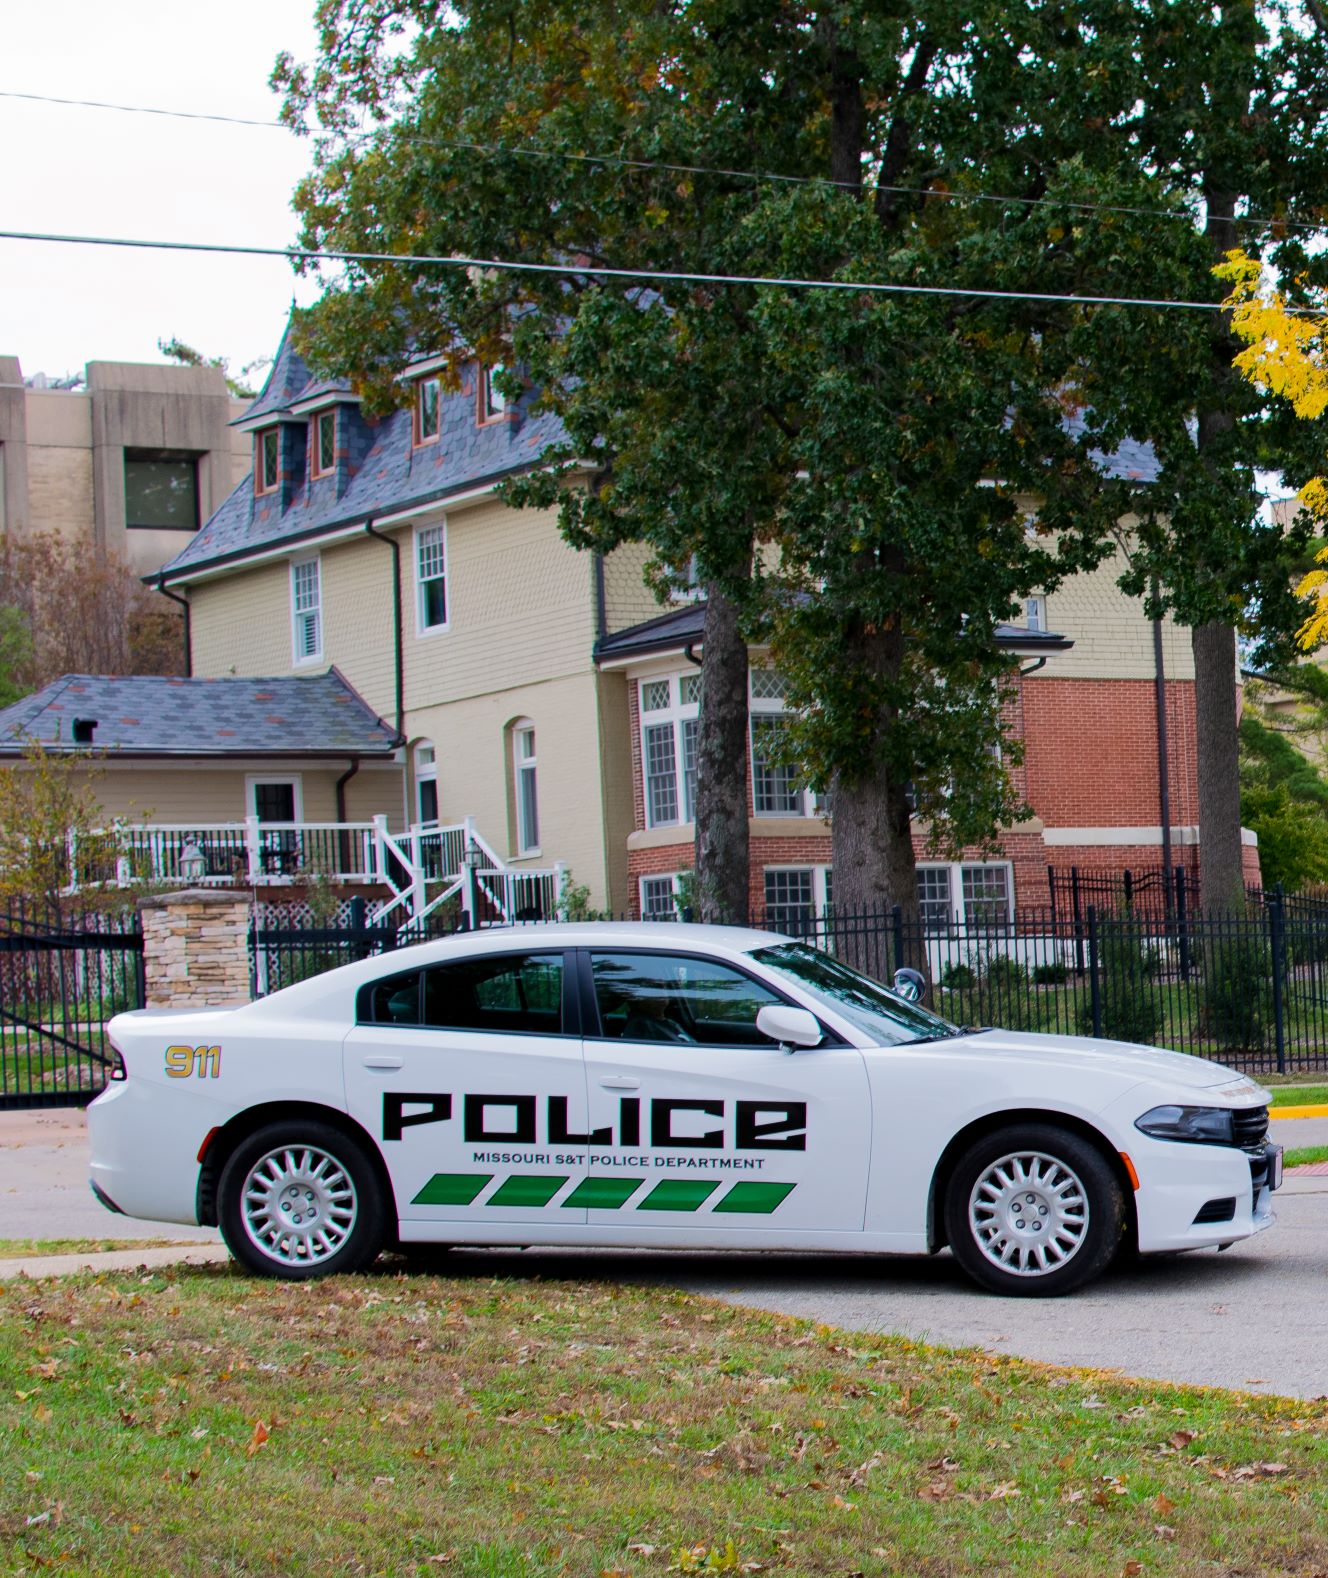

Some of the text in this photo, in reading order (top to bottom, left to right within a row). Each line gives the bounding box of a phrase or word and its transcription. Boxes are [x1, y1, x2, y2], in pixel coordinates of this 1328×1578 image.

[164, 1045, 222, 1078] 911
[382, 1092, 807, 1151] POLICE
[473, 1152, 765, 1169] MISSOURI S&T POLICE DEPARTMENT
